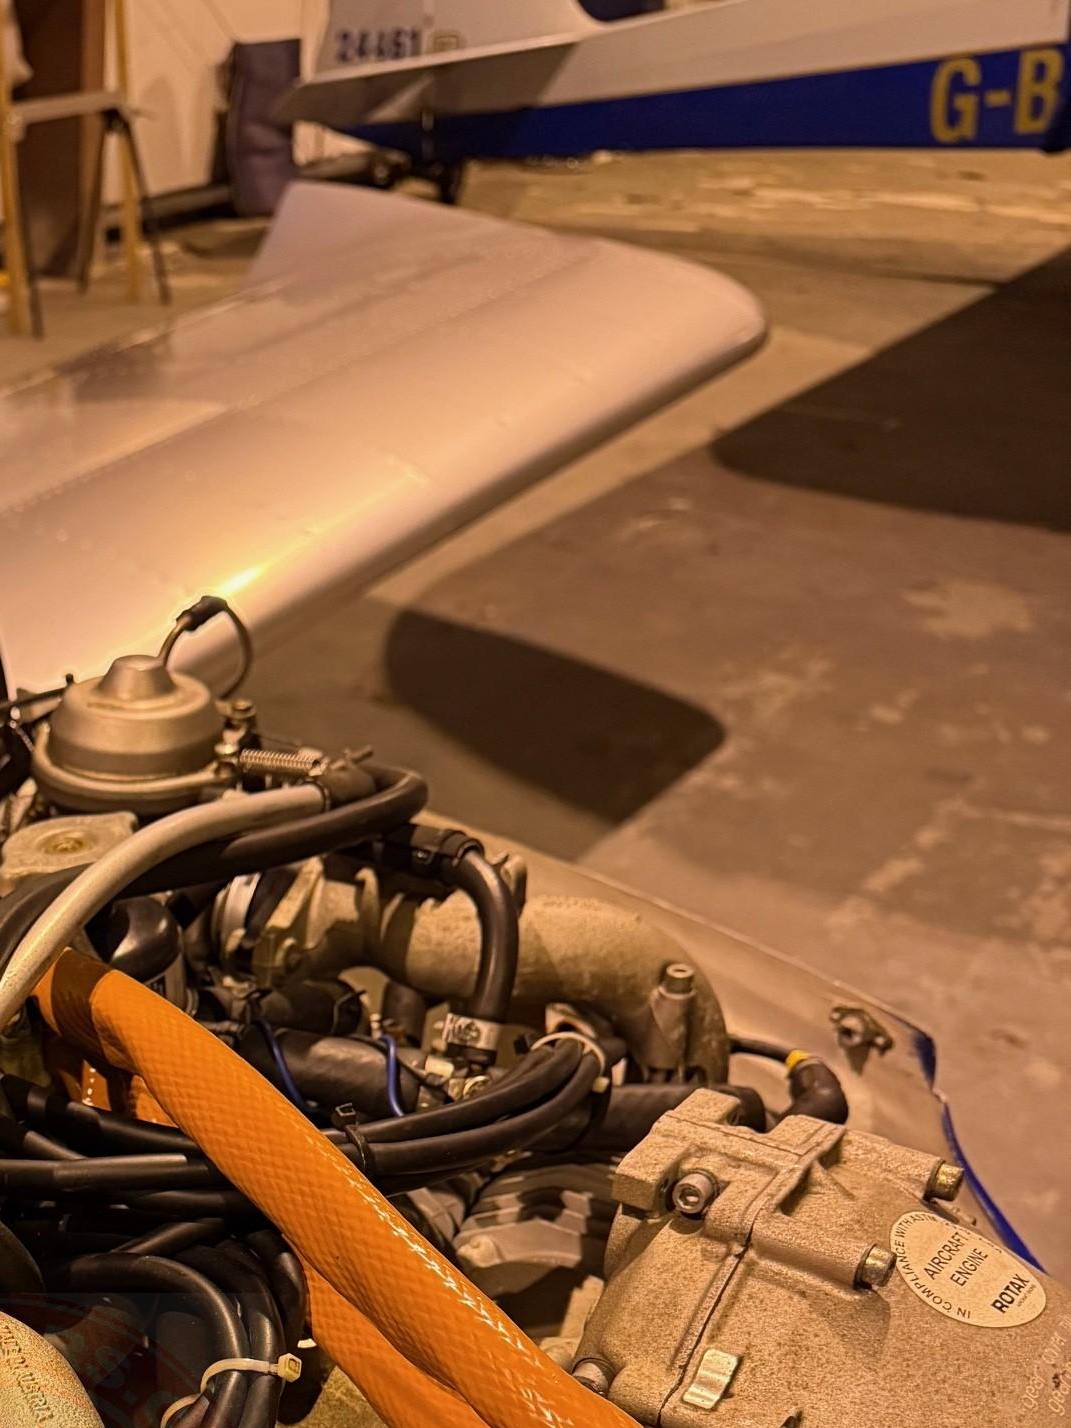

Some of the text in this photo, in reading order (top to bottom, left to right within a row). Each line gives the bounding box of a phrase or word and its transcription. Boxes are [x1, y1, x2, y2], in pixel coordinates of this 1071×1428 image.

[894, 1219, 912, 1238] WITH
[895, 1240, 952, 1311] COMPLIANCE
[923, 1232, 969, 1280] AIRCRAFT
[949, 1247, 989, 1287] ENGINE
[956, 1307, 971, 1319] IN
[991, 1273, 1029, 1314] ROTAX
